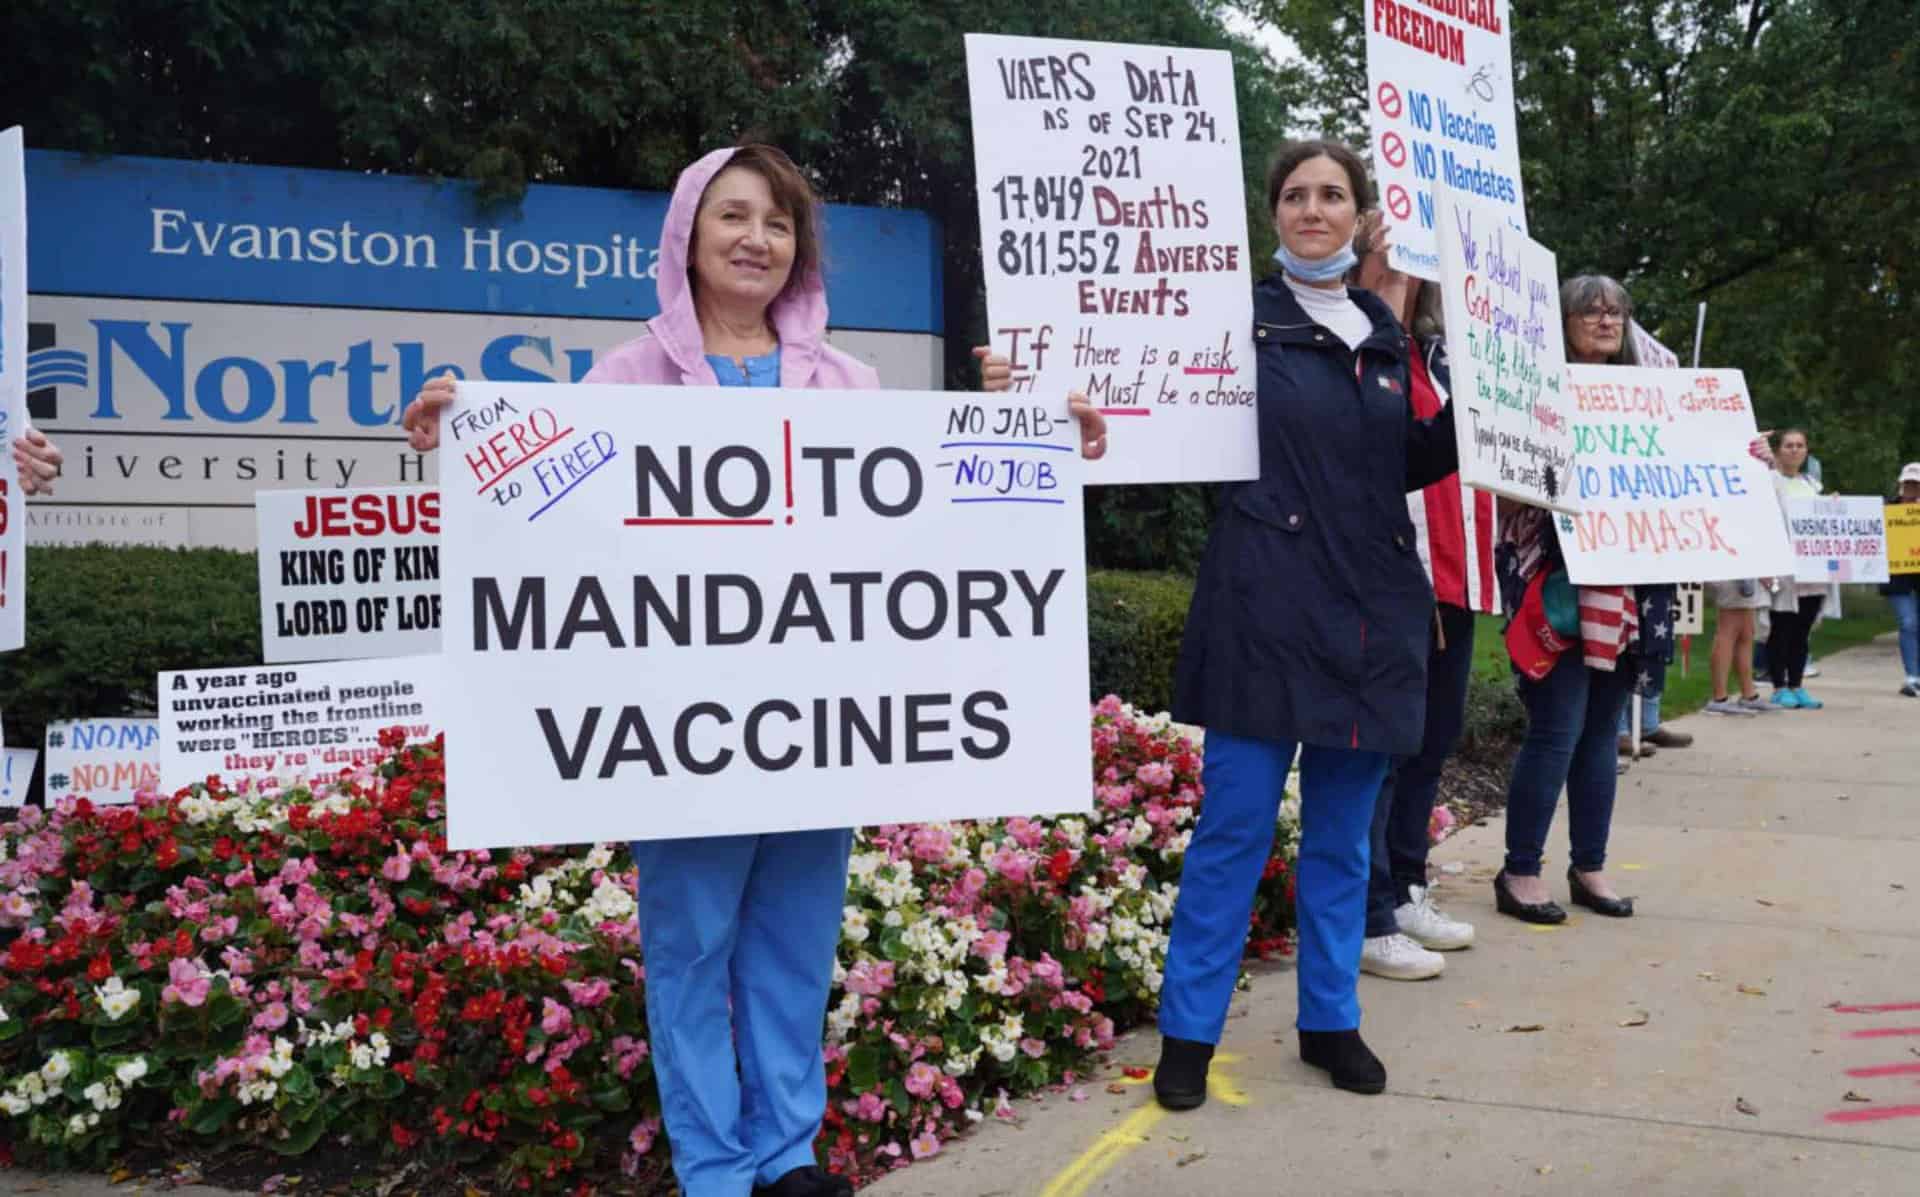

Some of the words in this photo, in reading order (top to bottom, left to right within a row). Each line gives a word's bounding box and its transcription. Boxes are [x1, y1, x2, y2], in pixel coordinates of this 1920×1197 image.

[1374, 0, 1465, 65] FREEDOM
[998, 52, 1096, 101] VAERS
[1408, 89, 1432, 132] NO
[1437, 97, 1497, 150] Vaccine
[1081, 145, 1143, 179] 2021
[1412, 140, 1436, 181] NO
[1442, 149, 1516, 204] Mandates
[150, 208, 437, 270] Evanston
[997, 325, 1053, 371] If
[1073, 327, 1121, 368] there
[1140, 345, 1158, 366] is
[1168, 350, 1180, 366] a
[1086, 370, 1146, 407] Must
[1157, 373, 1177, 405] be
[1190, 390, 1199, 404] a
[1205, 374, 1255, 408] choice
[450, 397, 519, 440] FROM
[947, 404, 984, 435] NO
[465, 408, 558, 483] HERO
[56, 446, 357, 489] iversity
[802, 446, 923, 518] TO
[996, 460, 1057, 494] JOB
[1609, 464, 1747, 500] MANDATE
[294, 492, 440, 538] JESUS
[492, 482, 523, 506] to
[1626, 508, 1737, 555] MASK
[280, 549, 344, 586] KING
[353, 547, 386, 583] OF
[276, 599, 348, 637] LORD
[356, 597, 388, 633] OF
[472, 569, 1065, 651] MANDATORY
[172, 675, 188, 691] A
[195, 674, 247, 692] year
[255, 671, 297, 688] ago
[172, 686, 330, 712] unvaccinated
[339, 680, 414, 704] people
[177, 713, 274, 731] working
[282, 709, 319, 725] the
[326, 702, 423, 722] frontline
[535, 690, 1011, 780] VACCINES
[177, 738, 236, 752] were
[224, 751, 307, 770] they're
